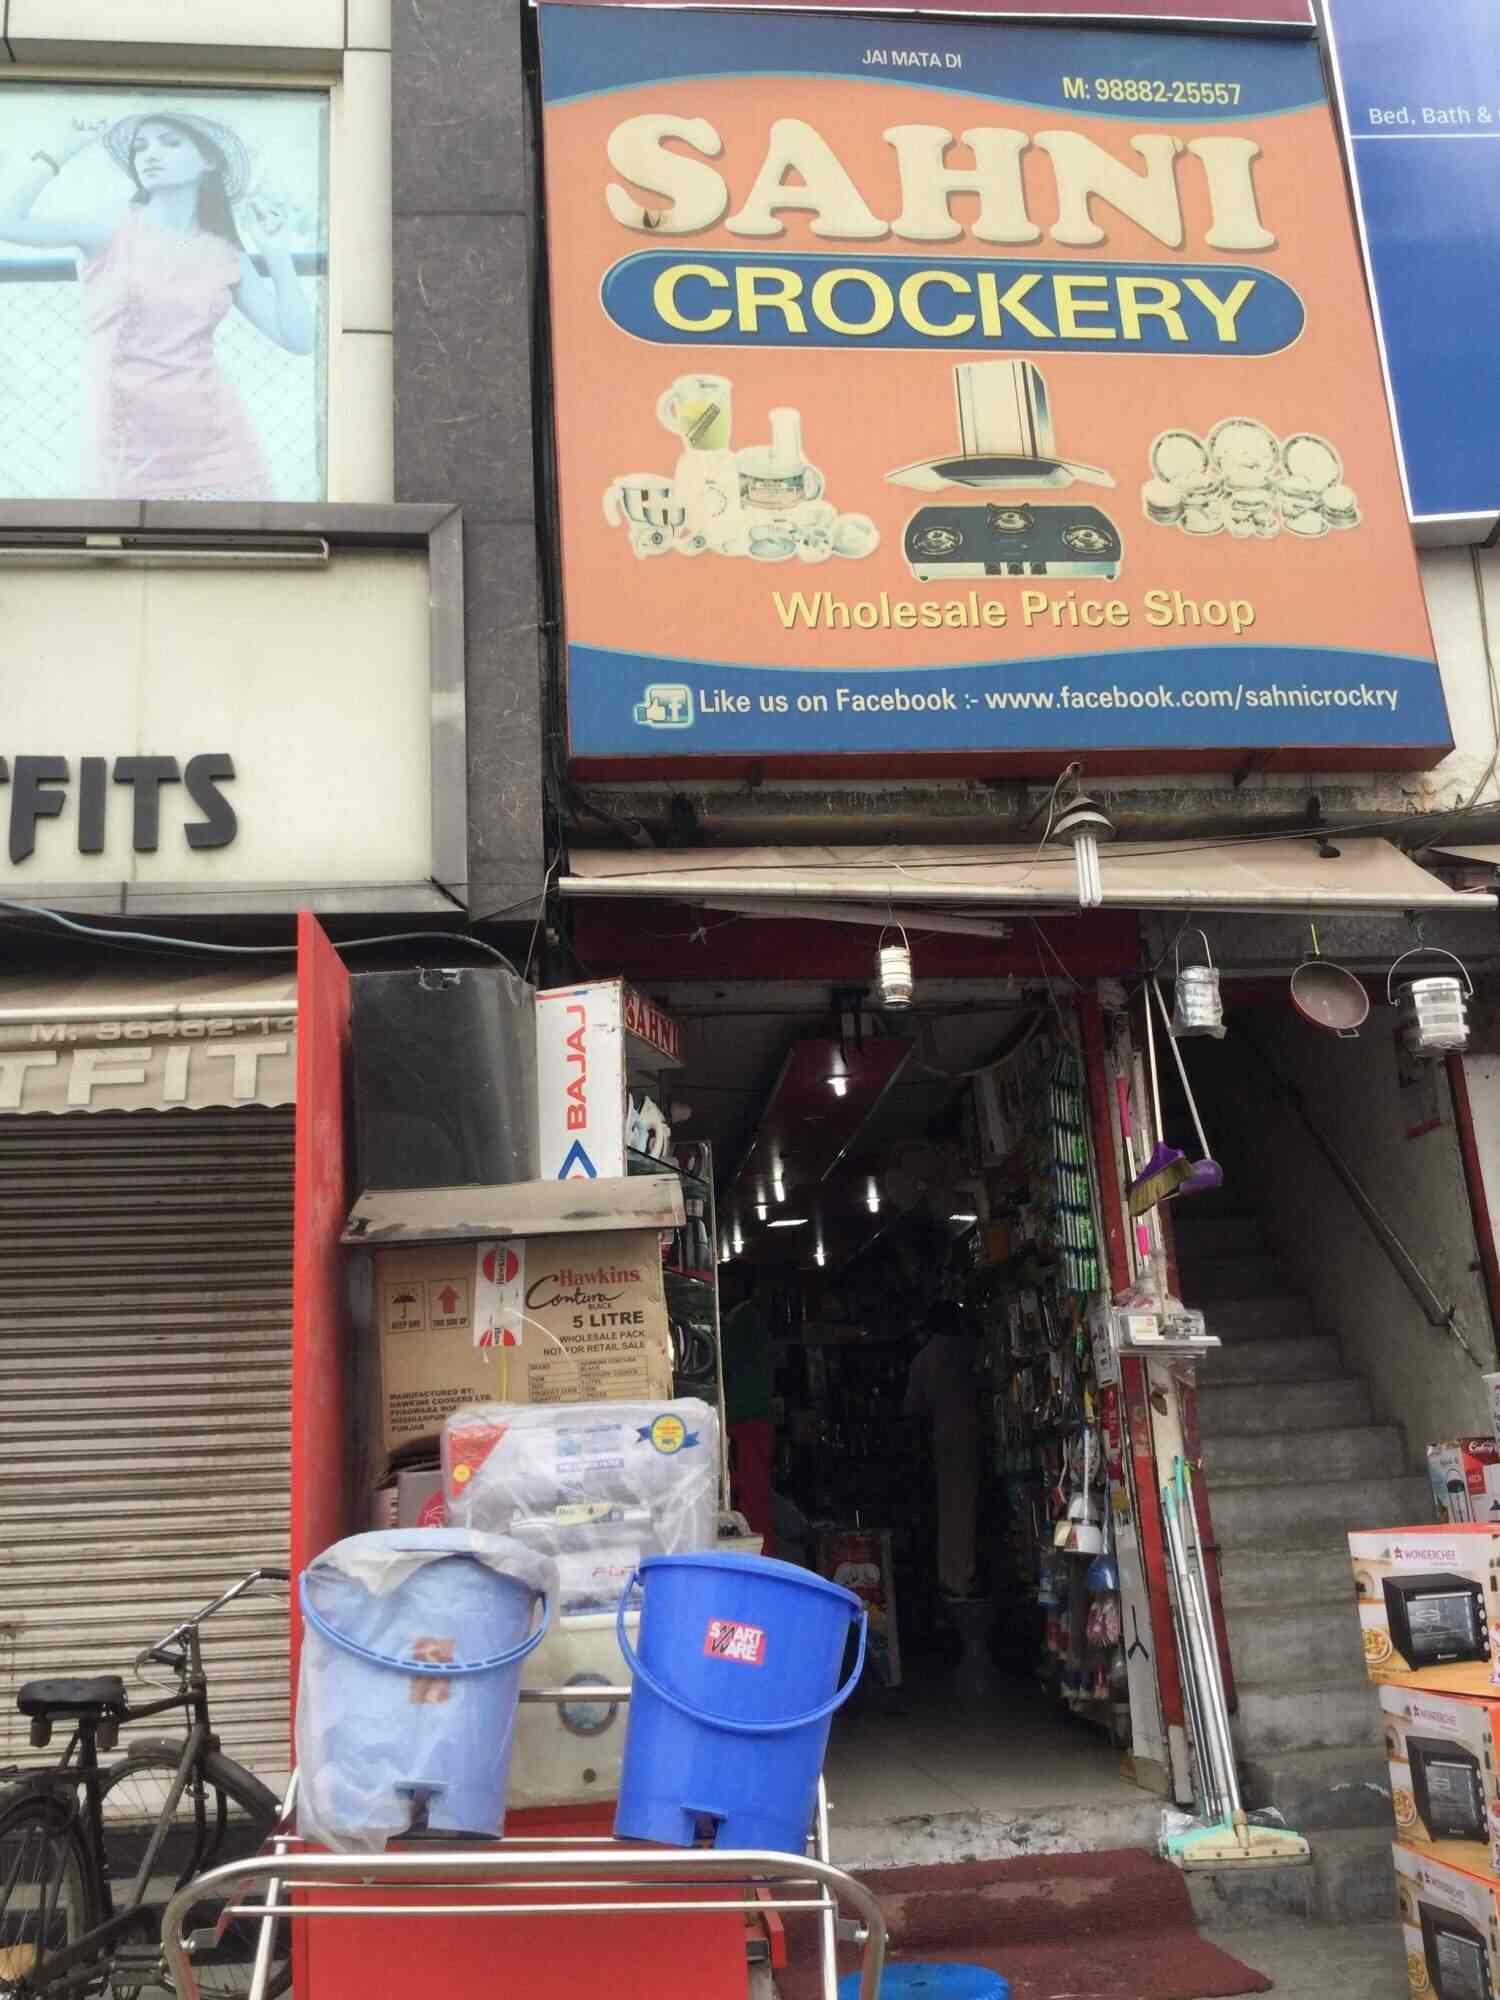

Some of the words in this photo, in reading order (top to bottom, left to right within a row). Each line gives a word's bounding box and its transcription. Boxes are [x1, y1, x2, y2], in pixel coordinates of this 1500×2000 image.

[861, 50, 888, 65] JAI
[891, 51, 942, 68] MATA
[945, 53, 962, 69] DI
[1062, 77, 1090, 99] M:
[1094, 78, 1241, 105] 98882-25557
[1421, 105, 1471, 124] Bath
[1478, 106, 1493, 124] &
[606, 113, 1276, 250] SAHNI
[652, 263, 1256, 344] CROCKERY
[772, 591, 1008, 629] Wholesale
[1021, 590, 1130, 627] Price
[1143, 590, 1256, 635] Shop
[699, 689, 750, 713] Like
[758, 694, 789, 712] us
[797, 694, 828, 712] on
[836, 688, 957, 713] Facebook
[985, 683, 1399, 712] www.facebook.com/sahnicrockry
[566, 1003, 588, 1131] BAJAJ
[559, 1266, 640, 1288] Hawkins
[525, 1273, 625, 1310] Contura
[573, 1315, 584, 1329] 5
[589, 1311, 645, 1327] LITRE
[543, 1347, 562, 1356] NOT
[586, 1343, 620, 1353] RETAIL
[622, 1340, 646, 1350] SALE
[559, 1331, 618, 1344] WHOLESALE
[620, 1329, 646, 1339] PACK
